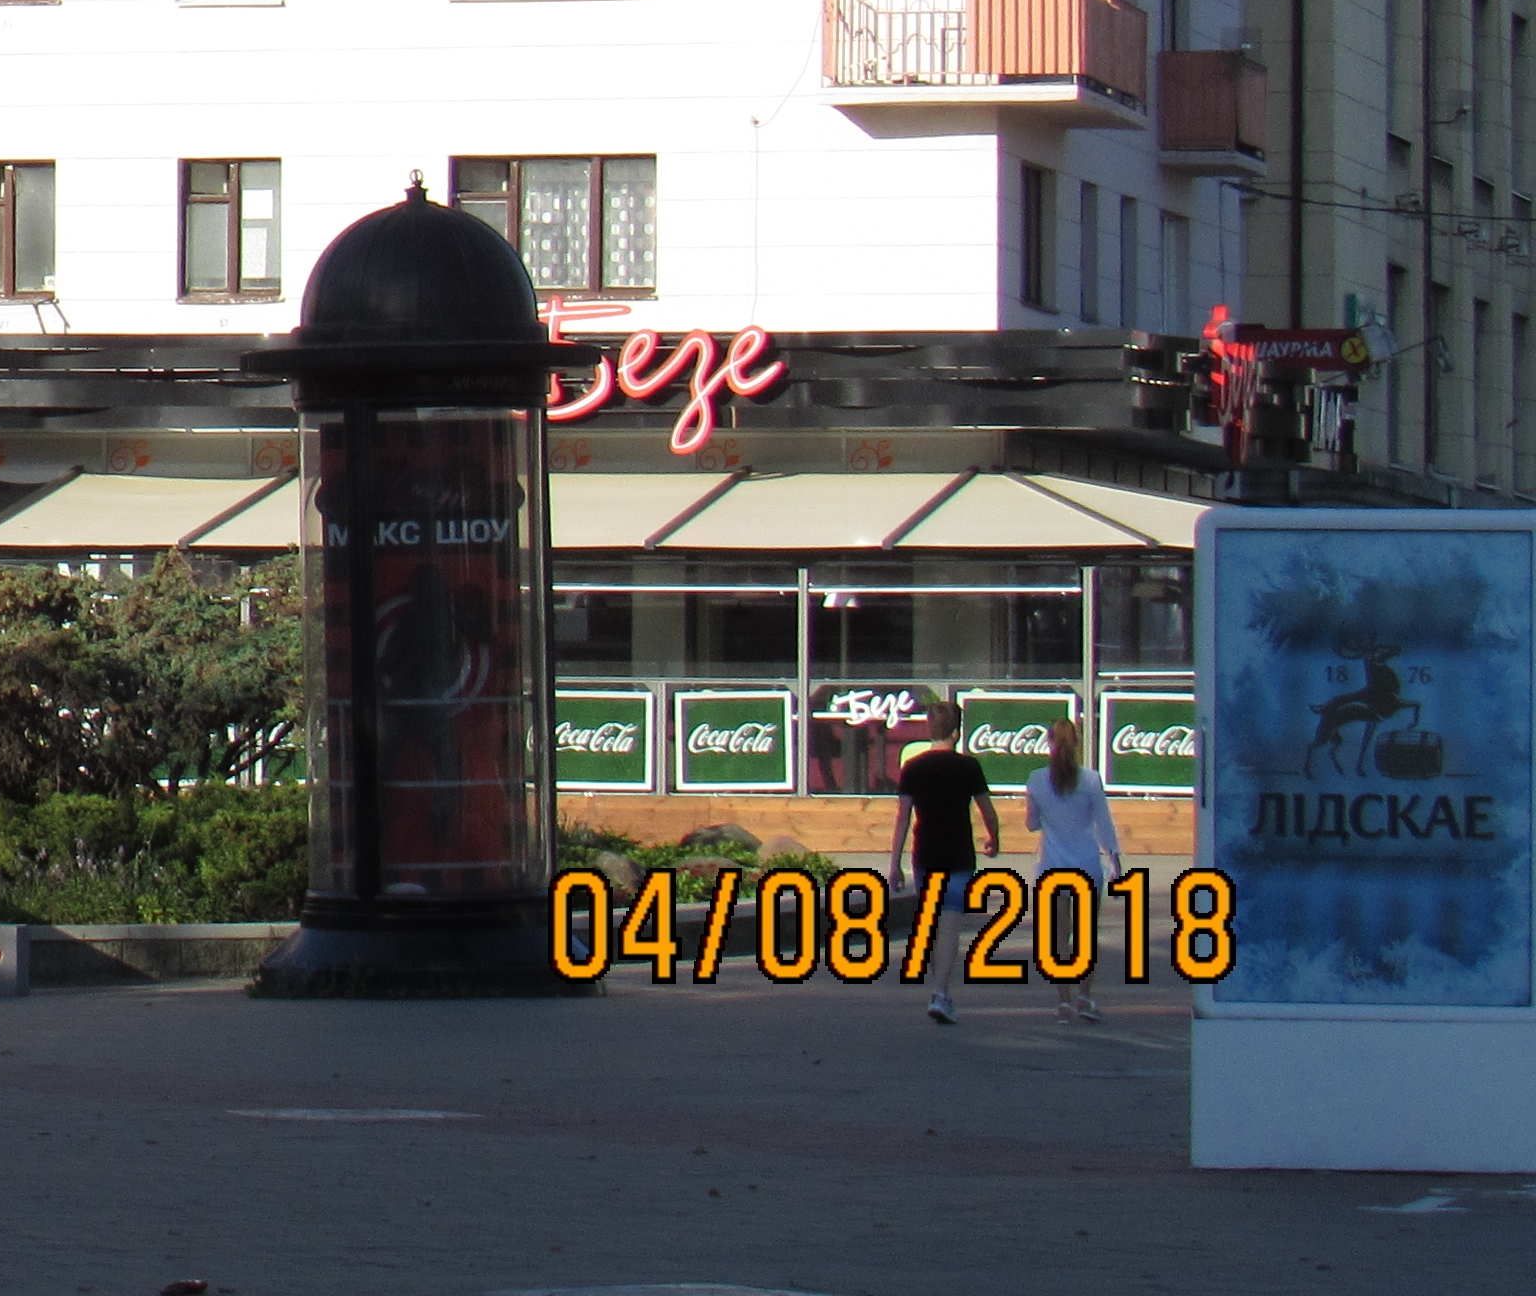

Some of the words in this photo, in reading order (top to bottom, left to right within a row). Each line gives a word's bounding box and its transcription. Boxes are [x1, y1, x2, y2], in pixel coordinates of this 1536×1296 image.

[328, 520, 421, 548] МКС
[435, 518, 511, 545] ШОУ
[1326, 665, 1349, 684] 18
[1407, 666, 1432, 685] 76
[687, 721, 778, 754] Coca-Cola
[1250, 791, 1496, 848] ЛІДСКАЕ
